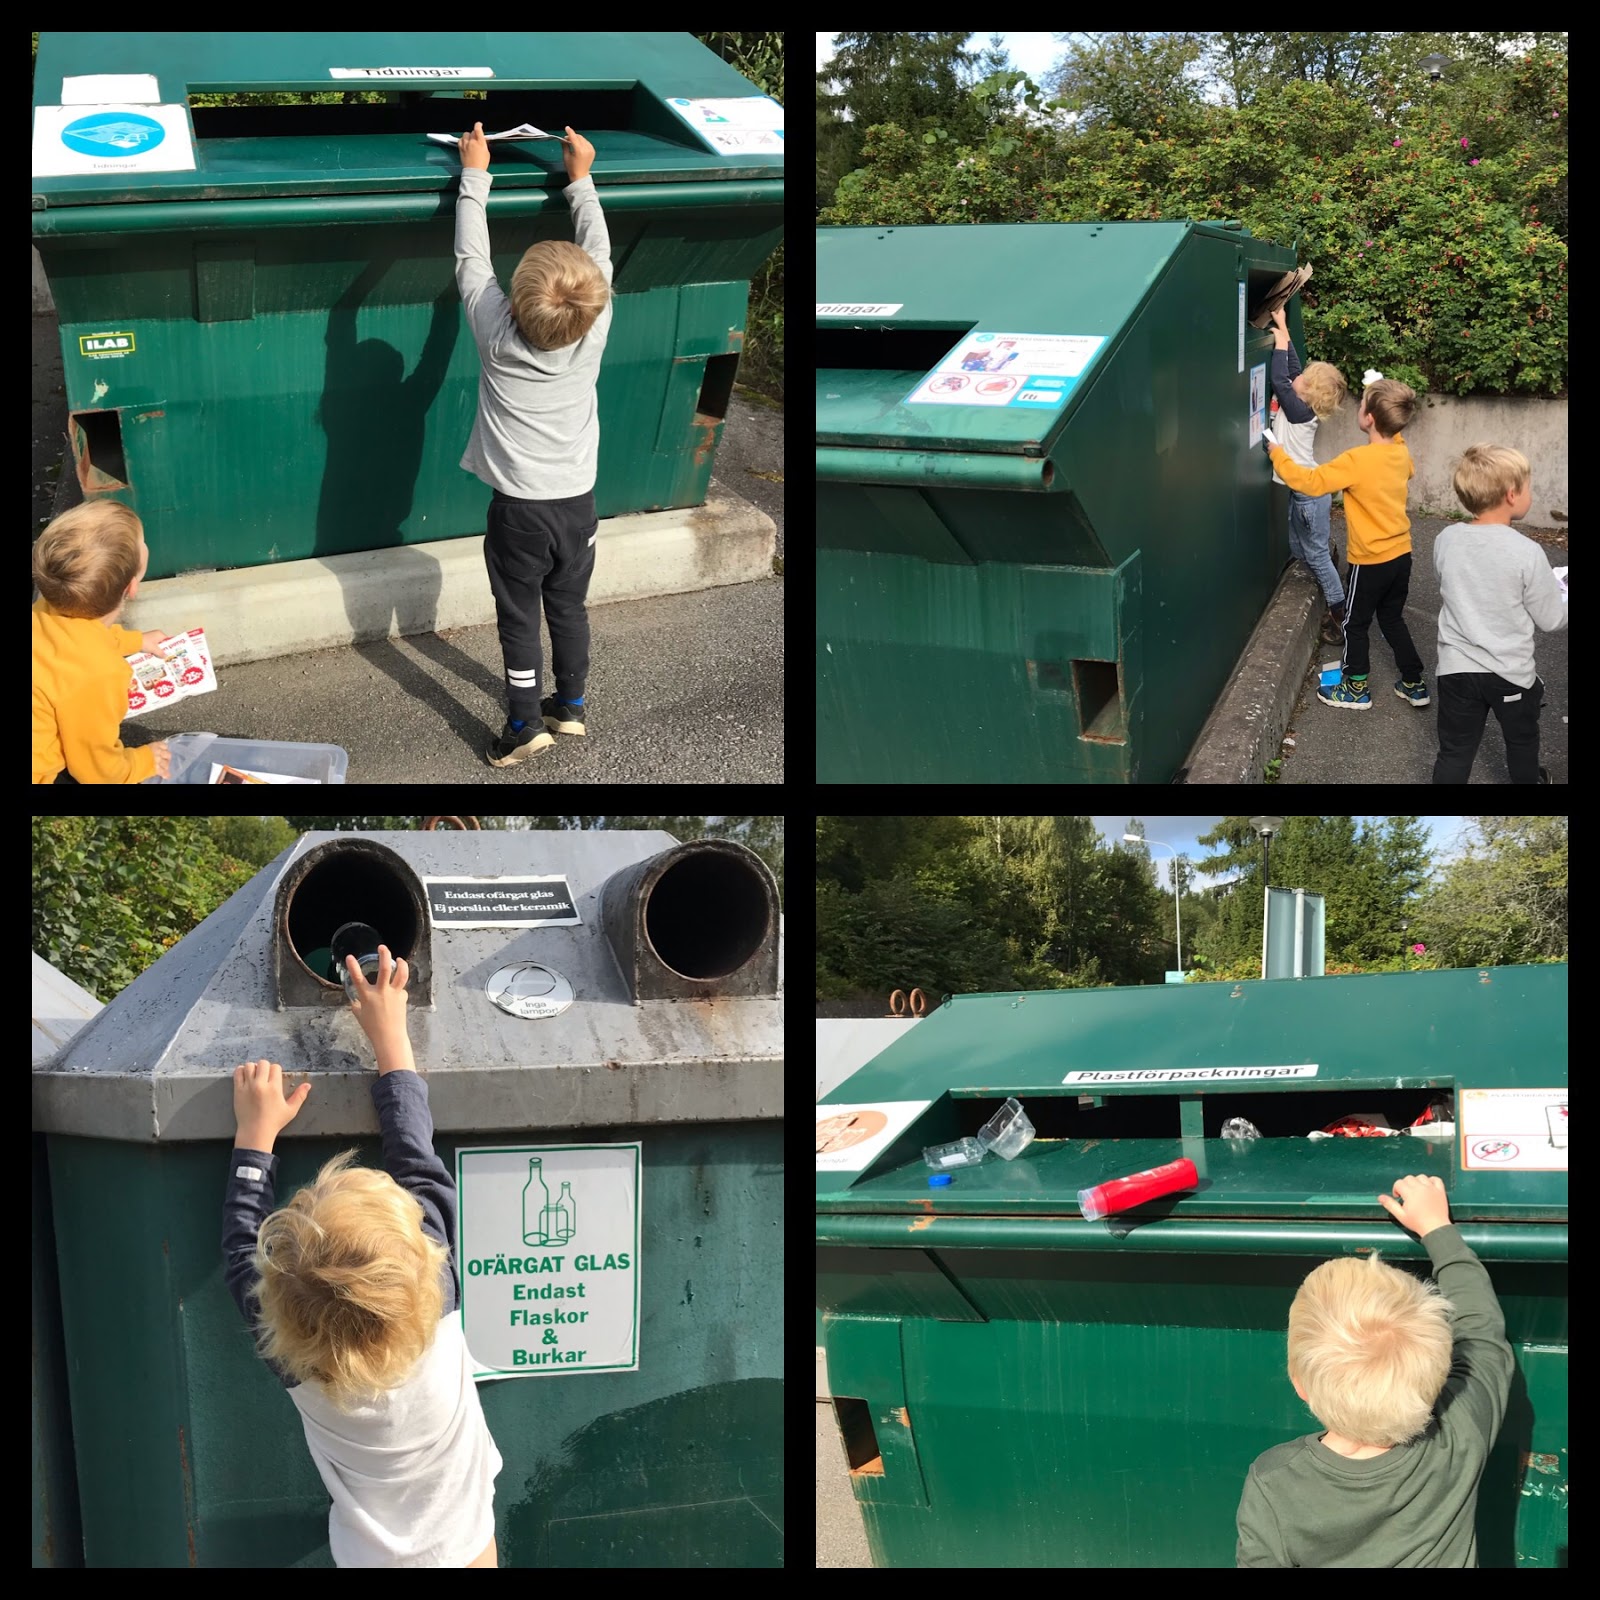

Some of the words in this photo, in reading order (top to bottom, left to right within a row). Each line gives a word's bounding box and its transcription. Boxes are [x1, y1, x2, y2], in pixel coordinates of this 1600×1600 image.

[817, 304, 888, 315] ningar
[86, 338, 129, 350] ILAB
[444, 890, 486, 899] Endast
[486, 890, 530, 900] ofärgat
[529, 890, 554, 900] glas
[433, 903, 446, 913] Ej
[448, 903, 491, 914] porslin
[492, 903, 520, 912] eller
[520, 902, 571, 911] keramik
[520, 1007, 559, 1015] lampor!
[525, 1001, 547, 1009] Inga
[1076, 1066, 1306, 1081] Plastförpackningar
[467, 1253, 566, 1276] OFÄRGAT
[574, 1253, 631, 1272] GLAS
[513, 1282, 586, 1301] Endast
[510, 1308, 589, 1326] Flaskor
[541, 1328, 559, 1345] &
[512, 1347, 587, 1366] Burkar
